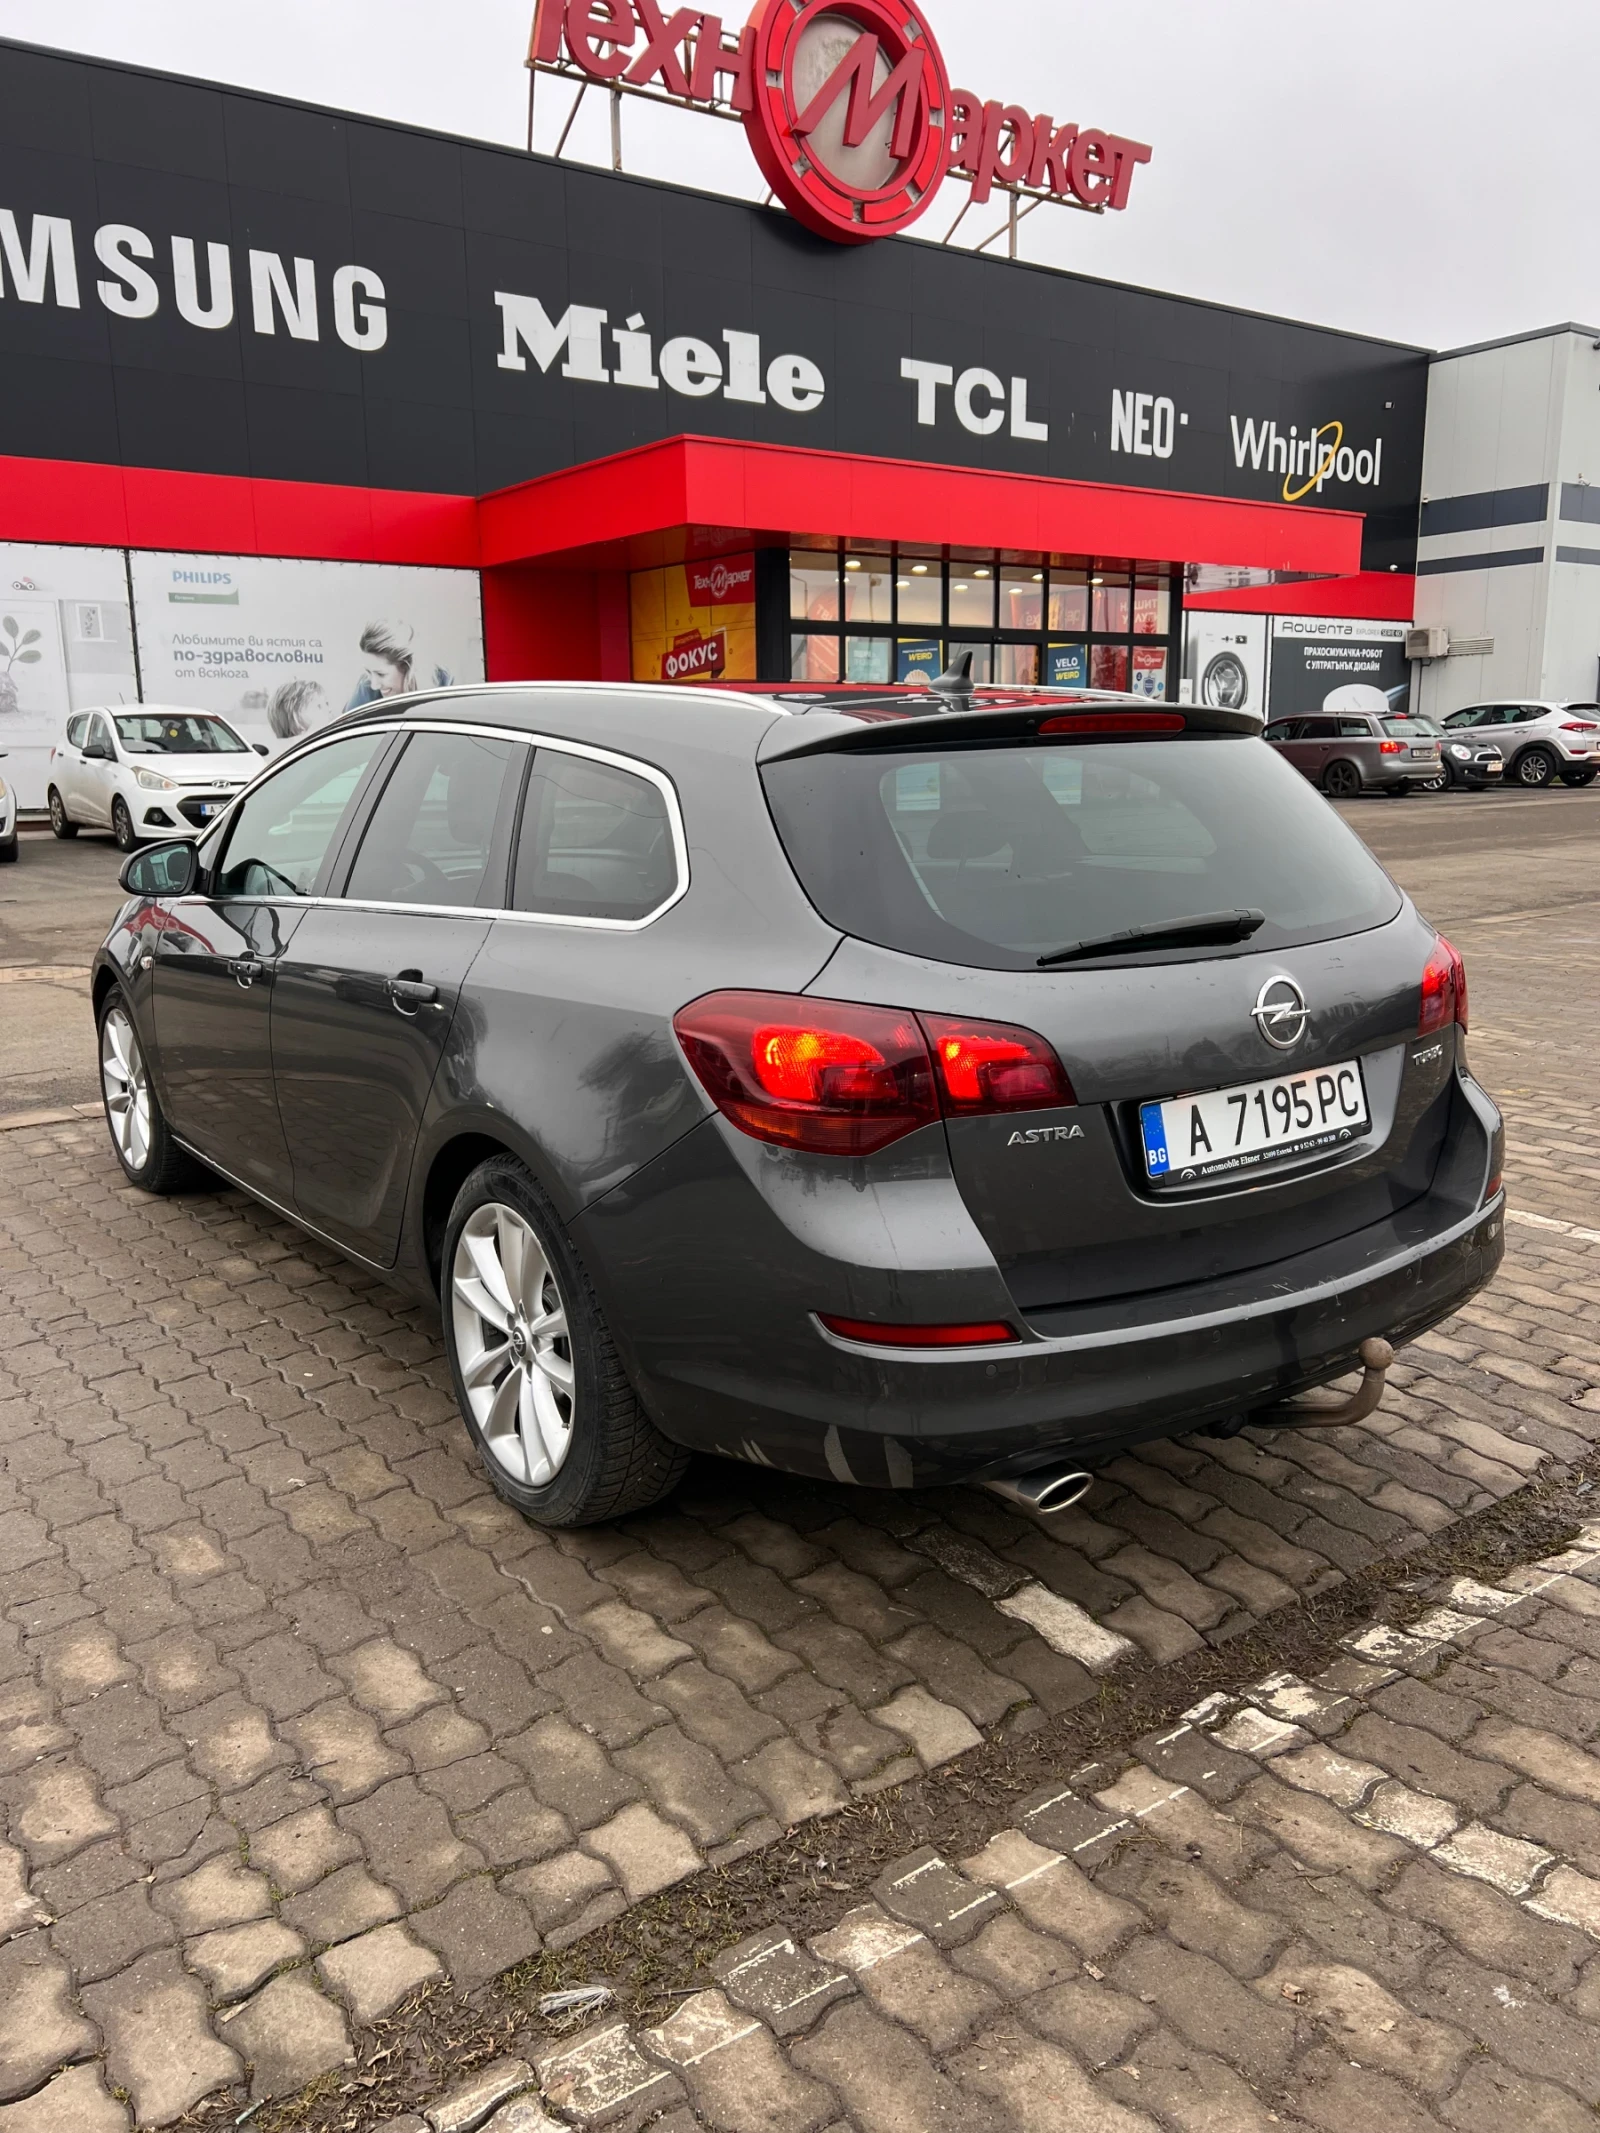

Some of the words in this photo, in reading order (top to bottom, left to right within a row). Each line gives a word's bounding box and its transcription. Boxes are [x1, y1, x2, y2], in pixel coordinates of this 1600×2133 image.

[493, 289, 826, 413] Miele
[901, 357, 1048, 442] TCL
[1111, 389, 1174, 459] NEO
[1230, 415, 1382, 492] Whirlpool
[172, 570, 232, 585] PHILIPS
[1282, 621, 1353, 635] Rowenta
[172, 633, 245, 646] Любимите
[248, 635, 263, 646] ви
[266, 637, 306, 648] ястия
[308, 638, 323, 648] са
[173, 648, 324, 665] по-здравословни
[665, 642, 718, 677] ФОКУС
[908, 651, 933, 662] WEIRD
[1303, 646, 1384, 658] ПРАХОСМУКАЧКА-РОБОТ
[1055, 656, 1079, 669] VELO
[1305, 660, 1311, 669] С
[1311, 660, 1353, 670] УЛТРАТЪНЪК
[1353, 660, 1380, 672] ДИЗАЙН
[175, 668, 195, 678] от
[198, 666, 249, 679] всякога
[1055, 670, 1080, 681] WEIRD
[1007, 1124, 1085, 1146] ASTRA
[1190, 1104, 1213, 1157] A
[1148, 1148, 1167, 1166] BG
